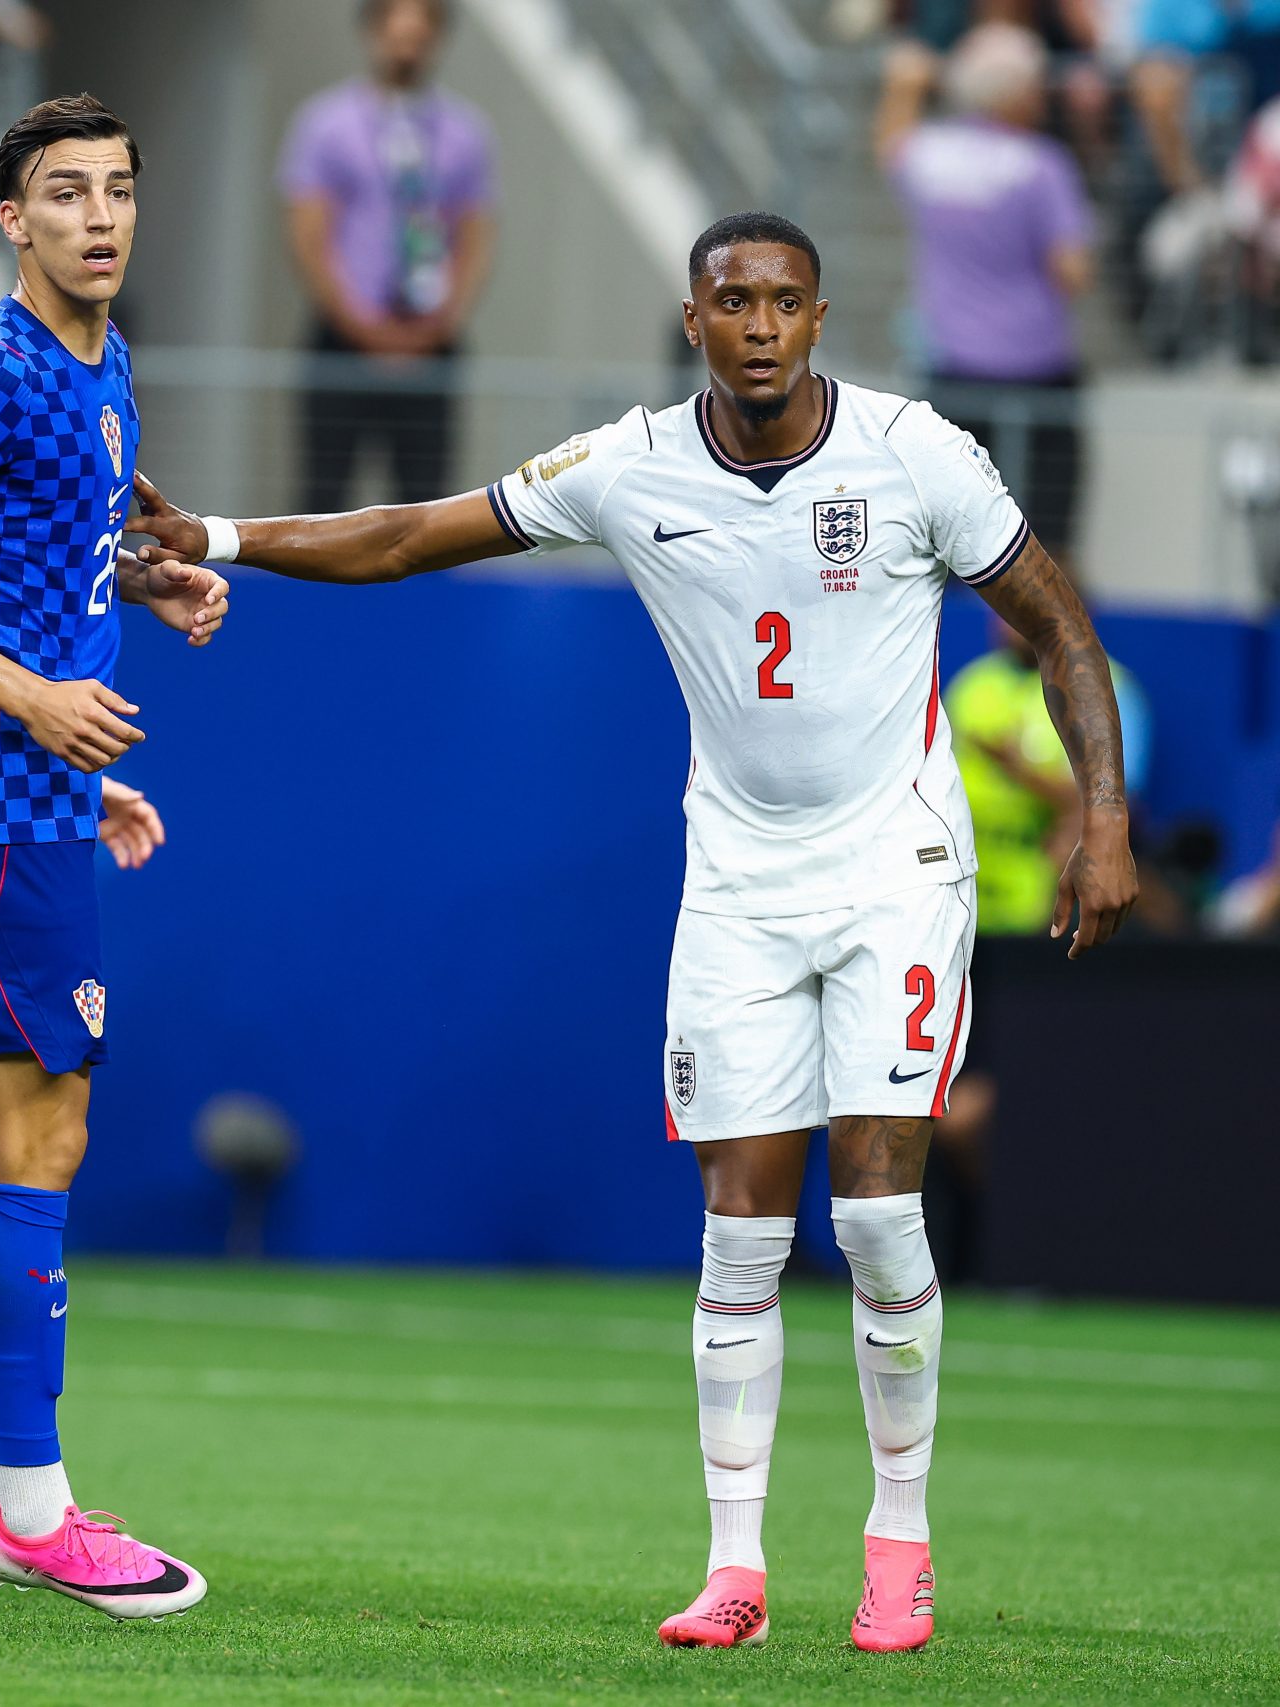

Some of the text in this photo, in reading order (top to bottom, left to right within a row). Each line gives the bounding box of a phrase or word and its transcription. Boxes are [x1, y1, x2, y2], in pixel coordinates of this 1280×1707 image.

[820, 568, 859, 580] CROATIA
[824, 581, 857, 593] 17.06.26
[755, 611, 793, 699] 2
[905, 964, 935, 1052] 2
